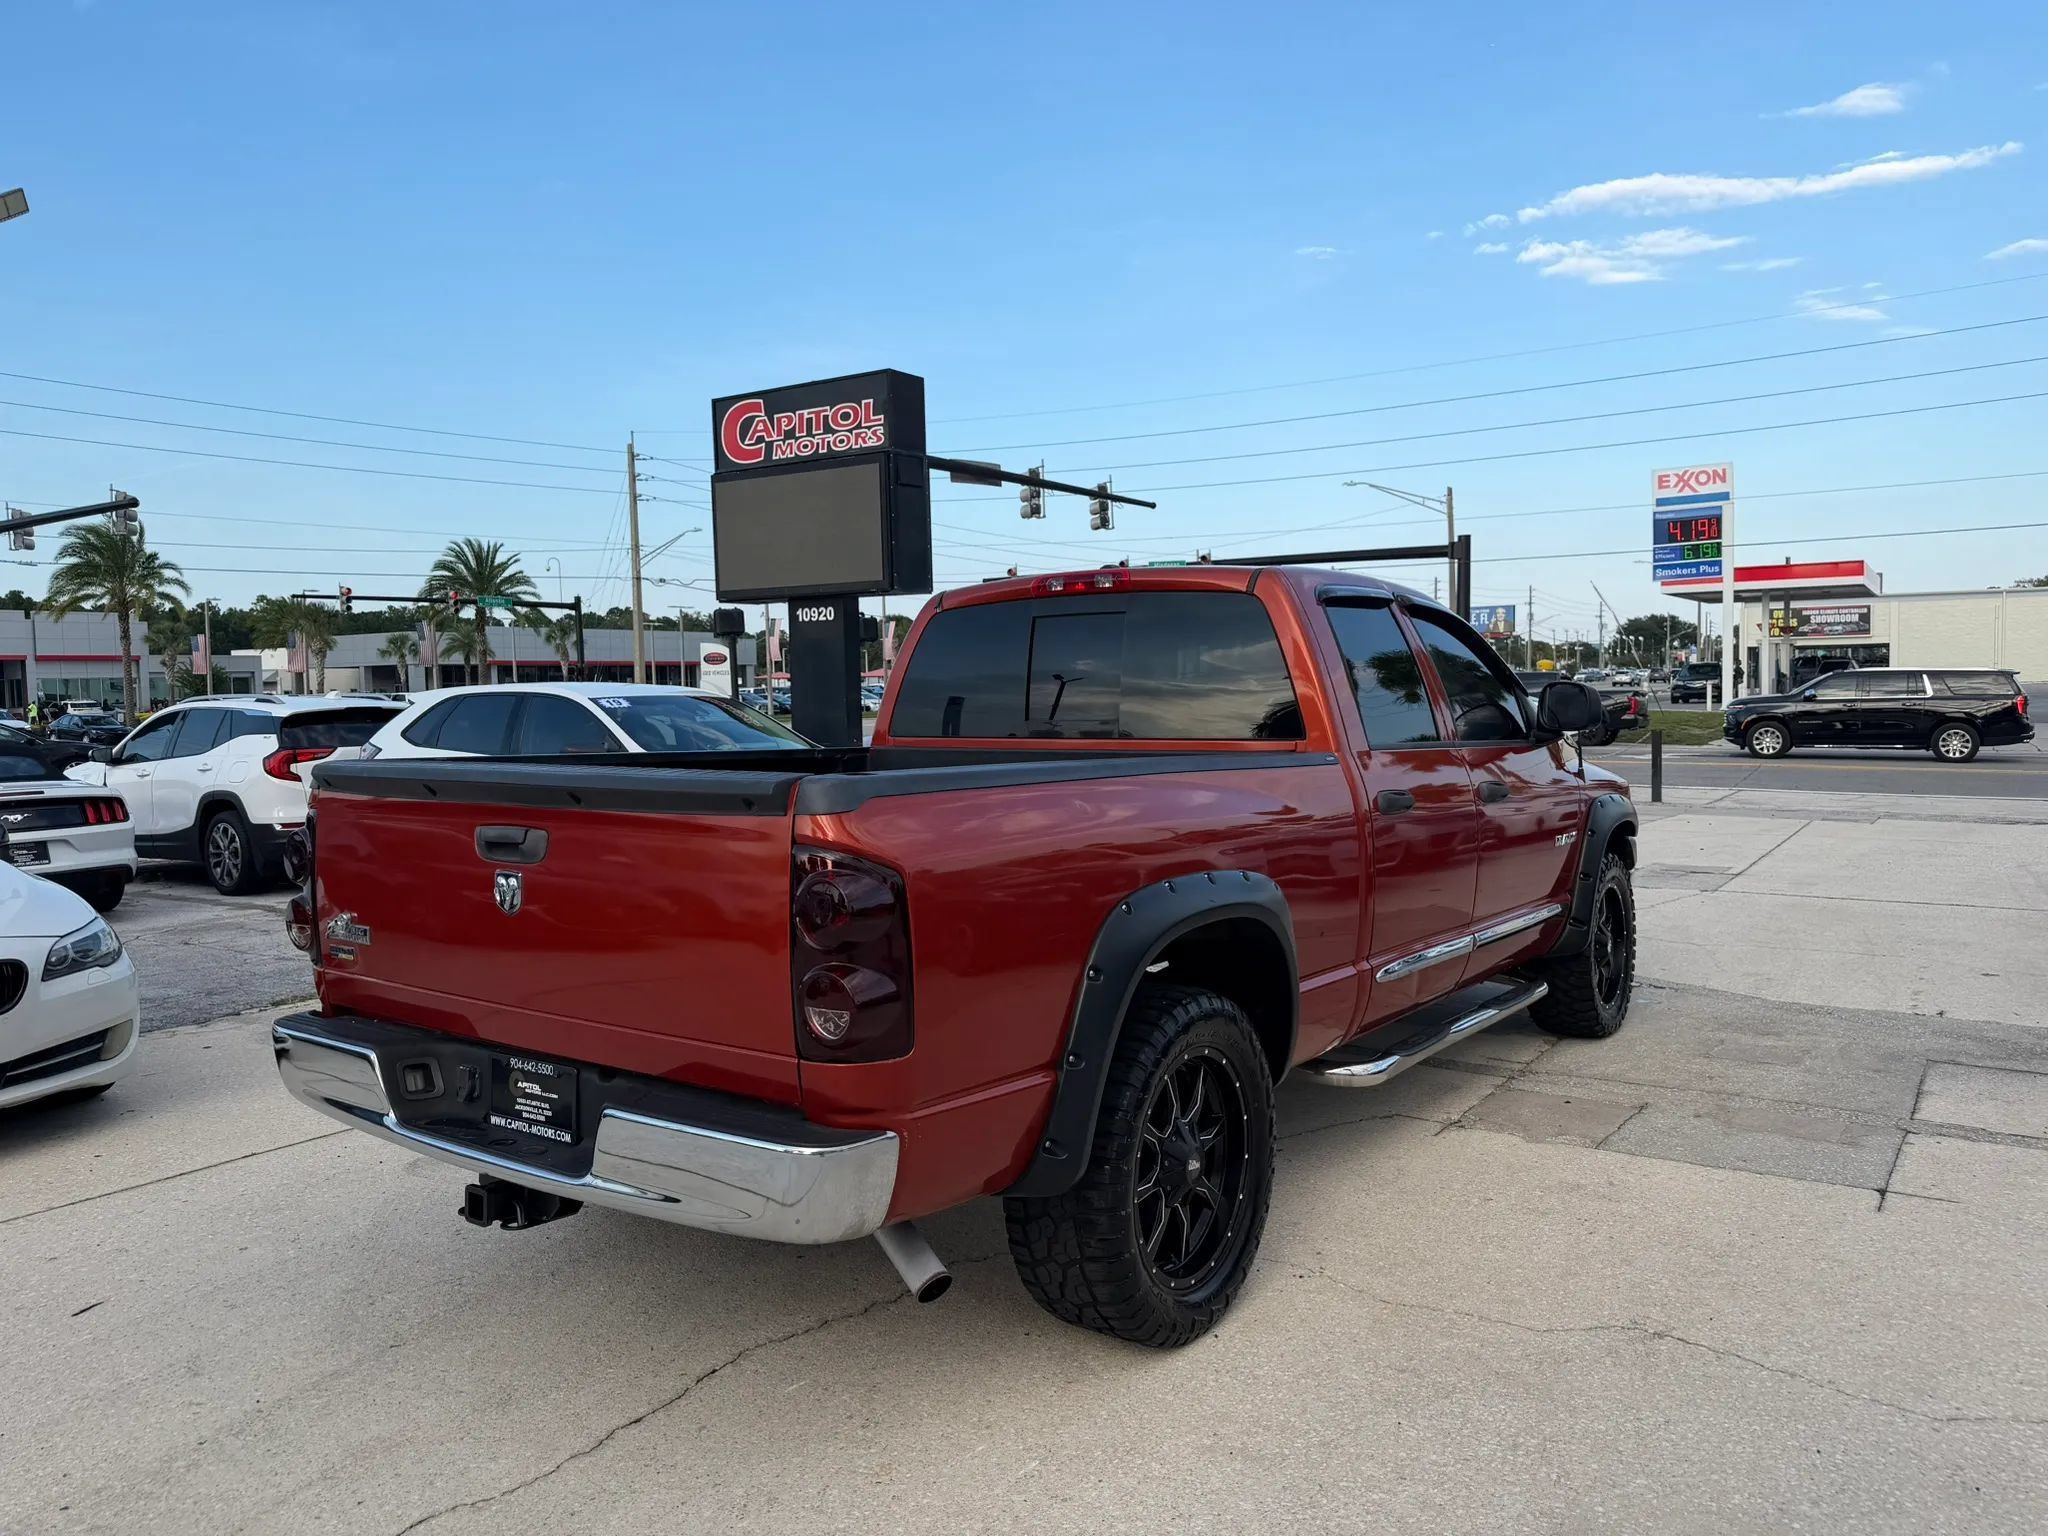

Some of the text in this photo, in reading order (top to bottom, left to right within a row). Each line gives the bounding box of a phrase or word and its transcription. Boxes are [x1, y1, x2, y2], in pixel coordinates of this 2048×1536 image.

[721, 399, 884, 464] CAPITOL
[772, 427, 885, 460] MOTORS
[1657, 468, 1727, 493] EXXON
[1655, 565, 1720, 577] Smokers Plus
[796, 606, 835, 622] 10920
[1810, 614, 1859, 623] SHOWROOM
[510, 1057, 554, 1076] 904-642-5500
[490, 1115, 572, 1143] WWW.CAPITOL-MOTORS.COM
